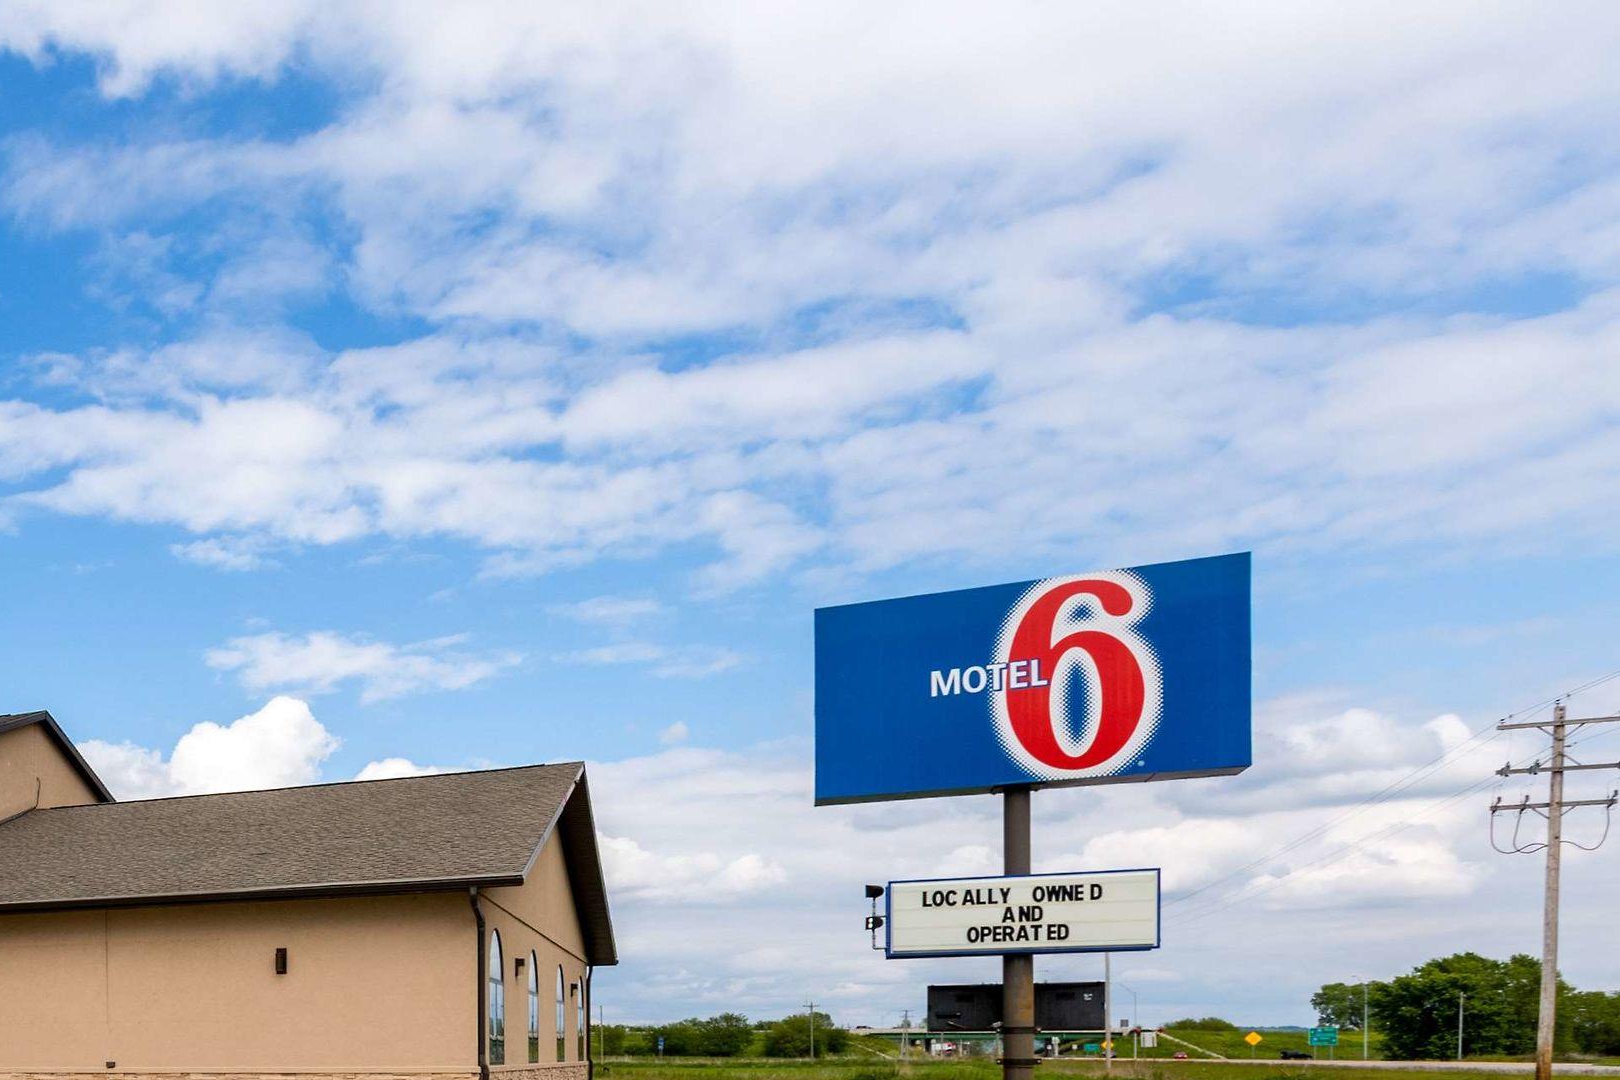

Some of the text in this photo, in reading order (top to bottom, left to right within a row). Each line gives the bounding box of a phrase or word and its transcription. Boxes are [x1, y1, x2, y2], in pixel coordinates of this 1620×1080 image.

[930, 578, 1146, 770] MOTEL 6
[922, 883, 1103, 907] LOCALLY OWNED
[1002, 905, 1044, 923] AND
[966, 923, 1069, 943] OPERATED
